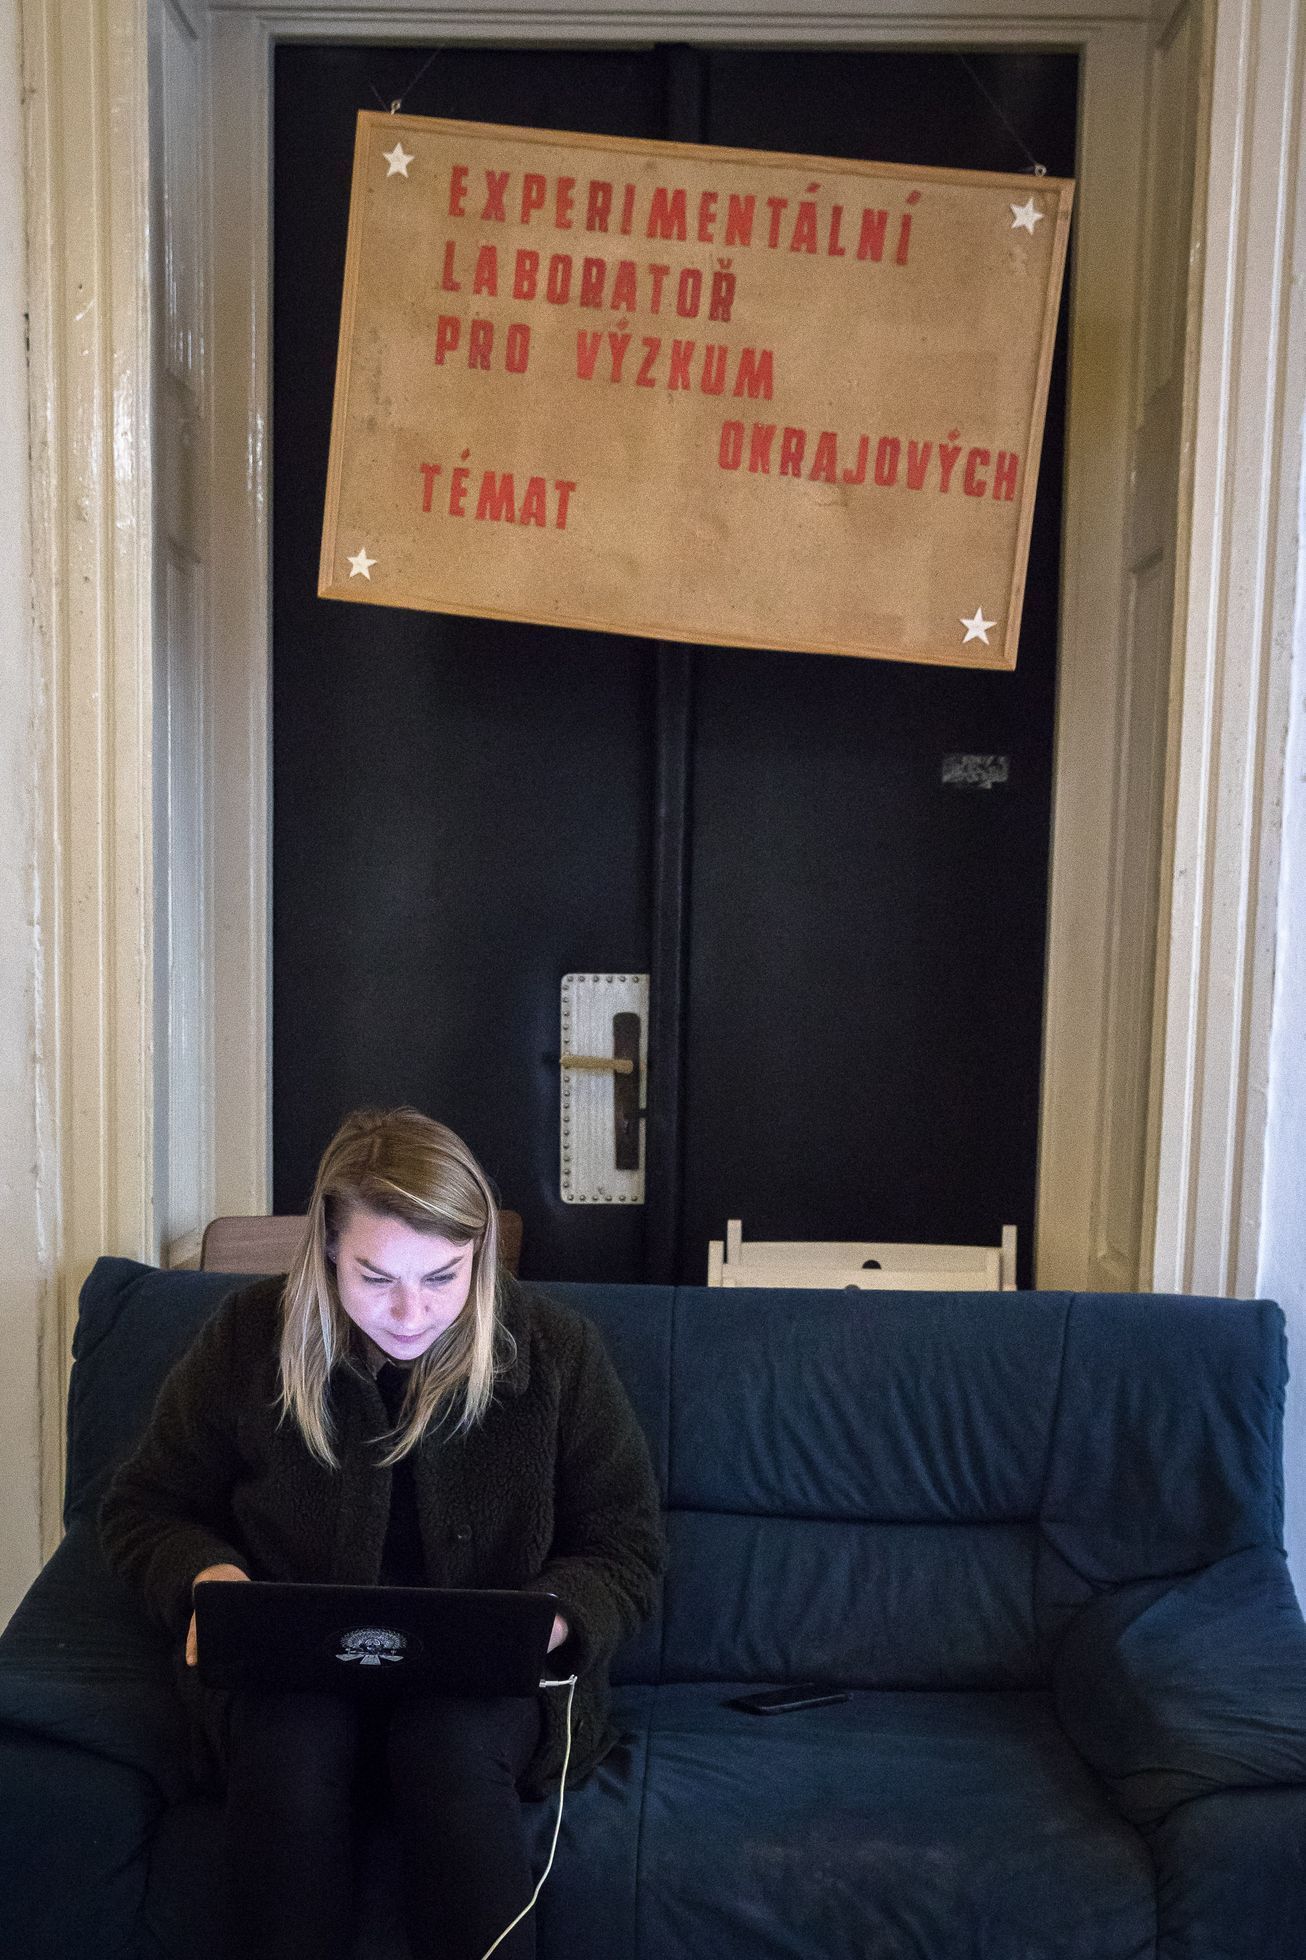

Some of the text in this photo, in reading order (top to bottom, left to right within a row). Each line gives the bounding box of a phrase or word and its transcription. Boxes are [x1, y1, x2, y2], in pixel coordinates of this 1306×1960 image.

[448, 165, 922, 265] EXPERIMENTÁLNÍ
[442, 240, 738, 323] LABORATOŘ
[435, 315, 776, 401] PRO VÝZKUM
[420, 448, 577, 529] TÉMAT
[718, 419, 1019, 501] OKRAJOVÝCH
